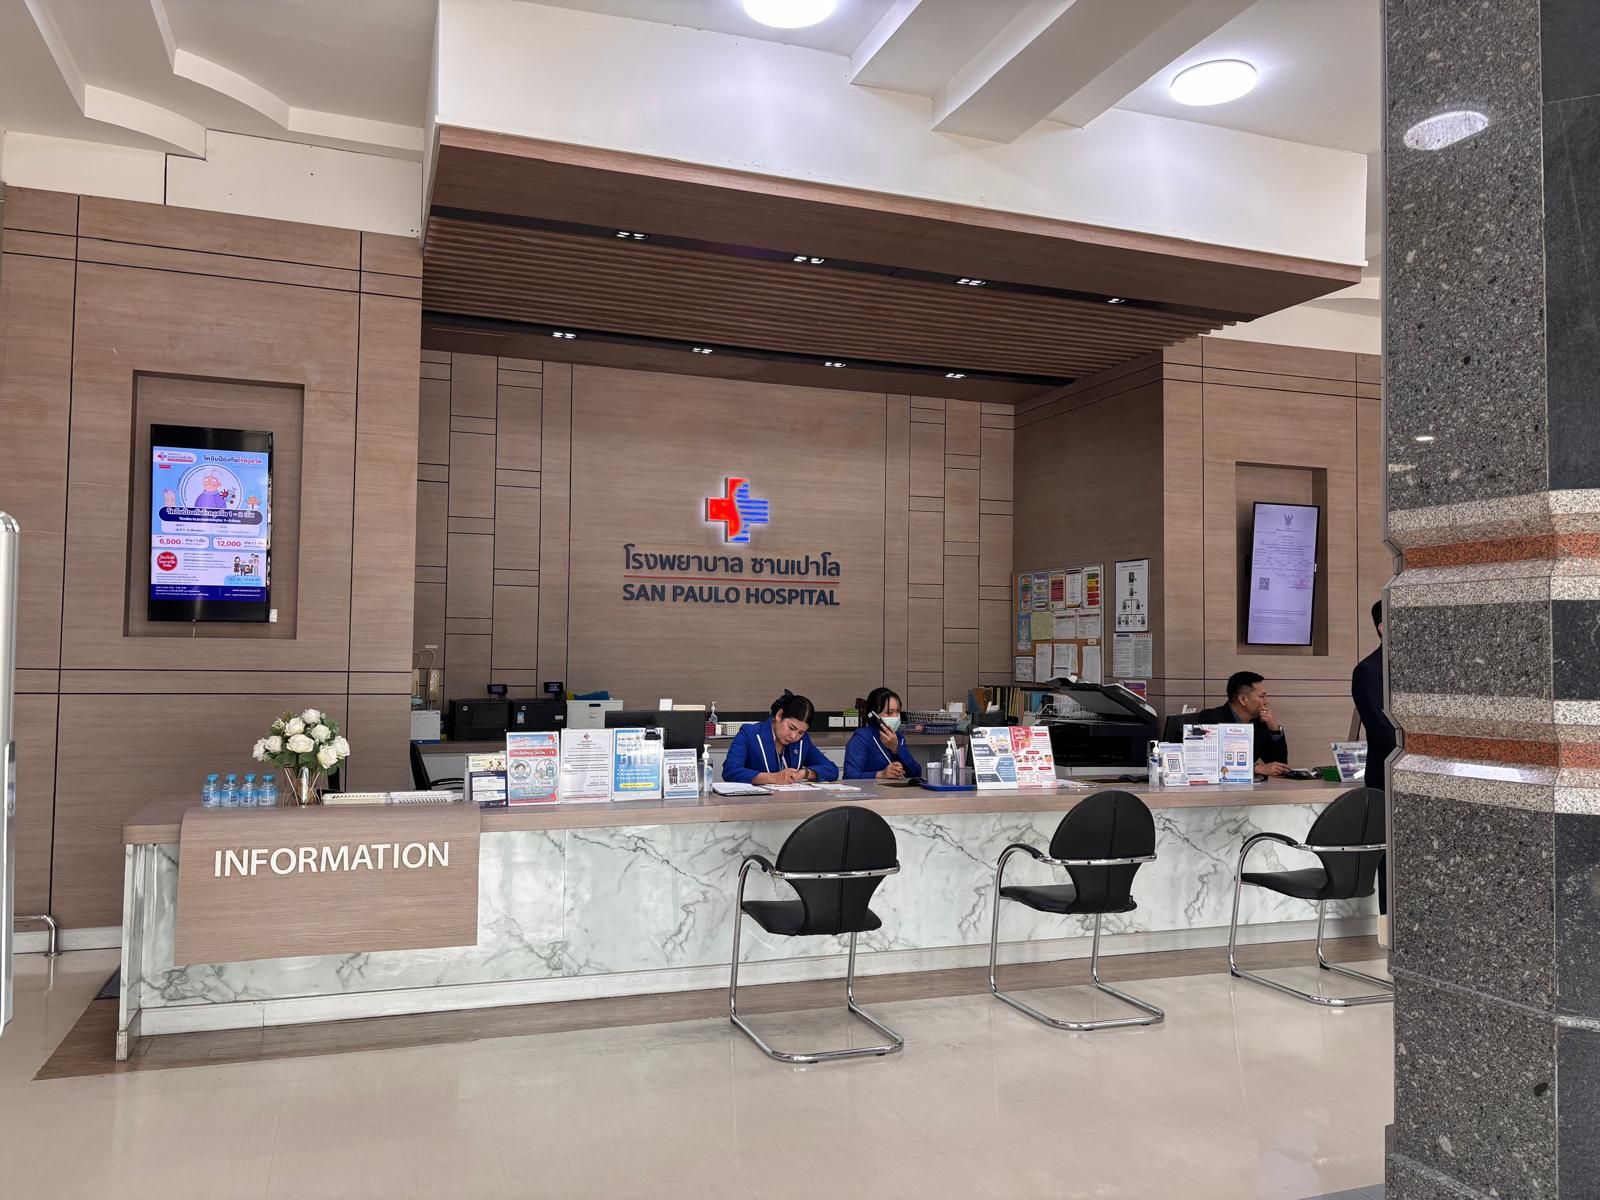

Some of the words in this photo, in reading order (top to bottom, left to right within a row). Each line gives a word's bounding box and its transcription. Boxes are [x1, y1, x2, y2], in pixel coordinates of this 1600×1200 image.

[623, 543, 743, 573] โรงพยาบาล
[751, 551, 841, 577] ซานเปาโล
[622, 583, 666, 602] SAN
[672, 584, 741, 604] PAULO
[745, 587, 841, 606] HOSPITAL
[213, 841, 450, 878] INFORMATION
